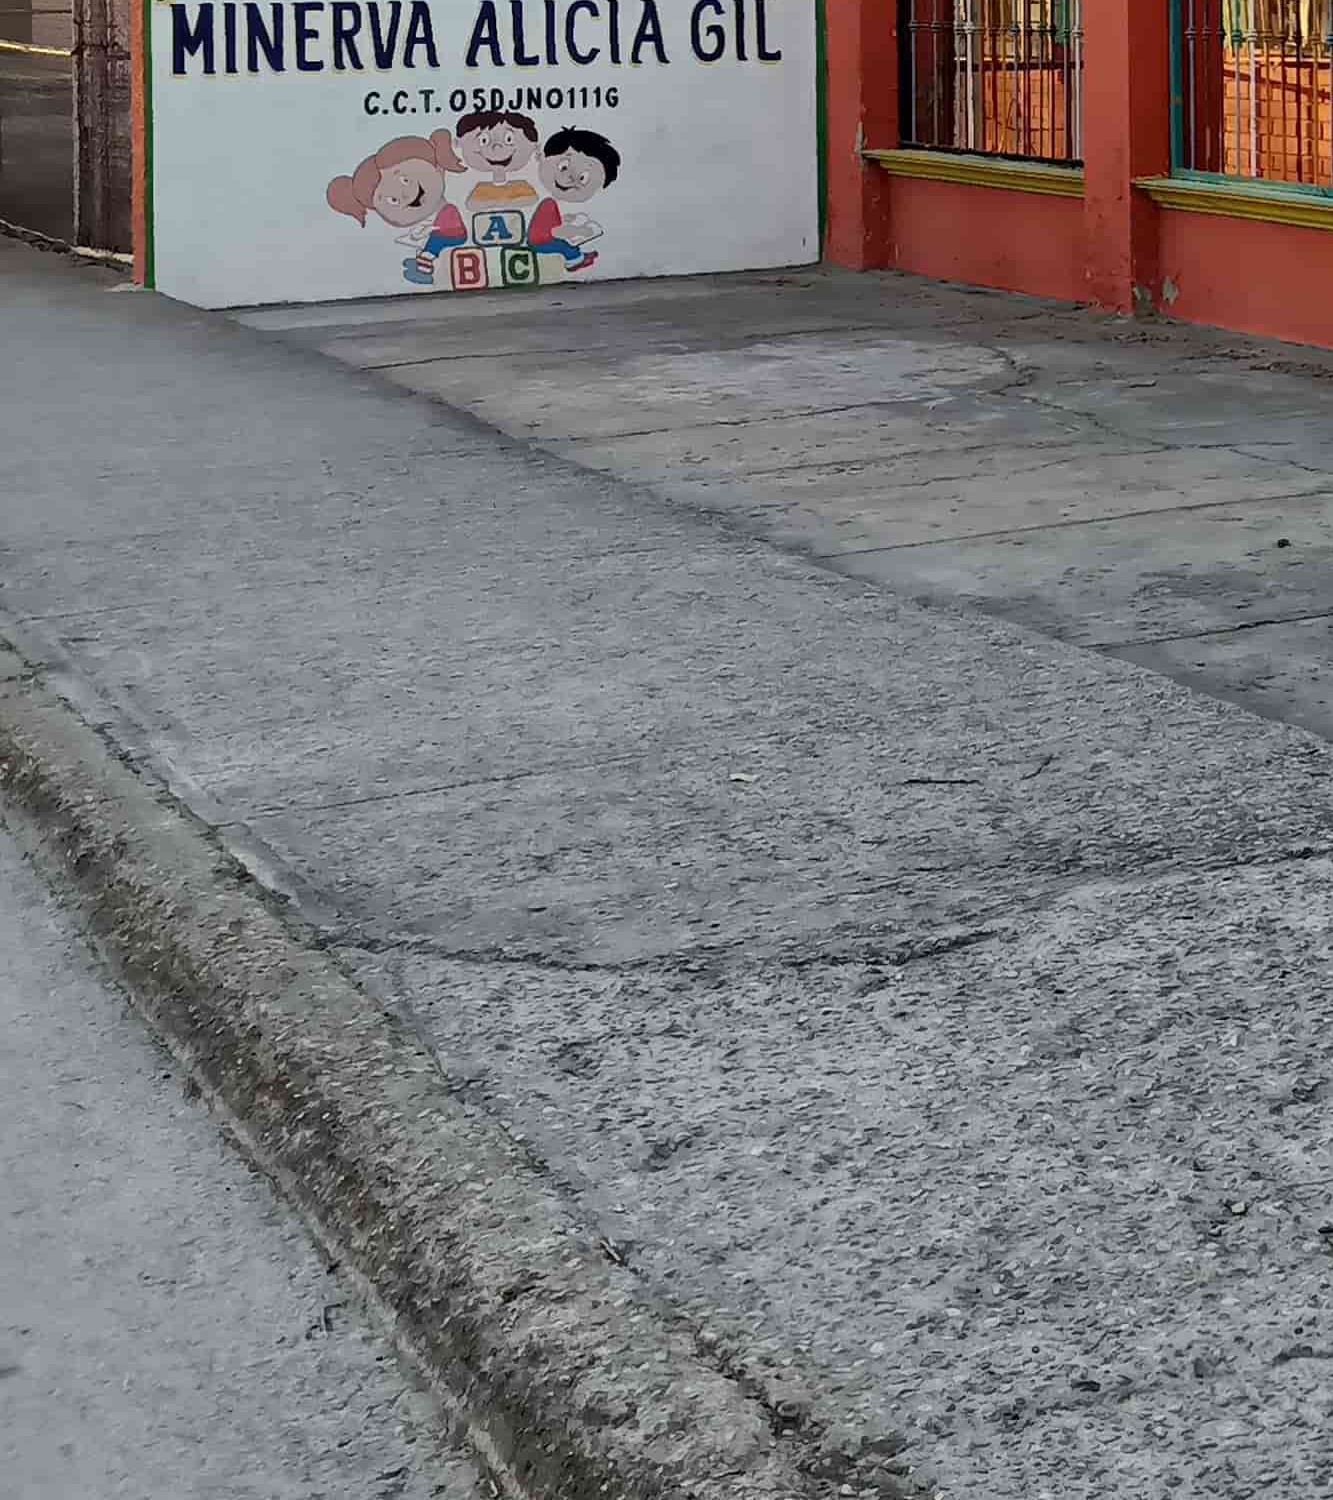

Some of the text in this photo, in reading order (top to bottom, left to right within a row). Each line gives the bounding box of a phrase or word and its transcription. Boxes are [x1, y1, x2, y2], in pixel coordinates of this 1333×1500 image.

[364, 89, 442, 116] C.C.T.
[481, 215, 513, 241] A
[458, 253, 531, 285] B C
